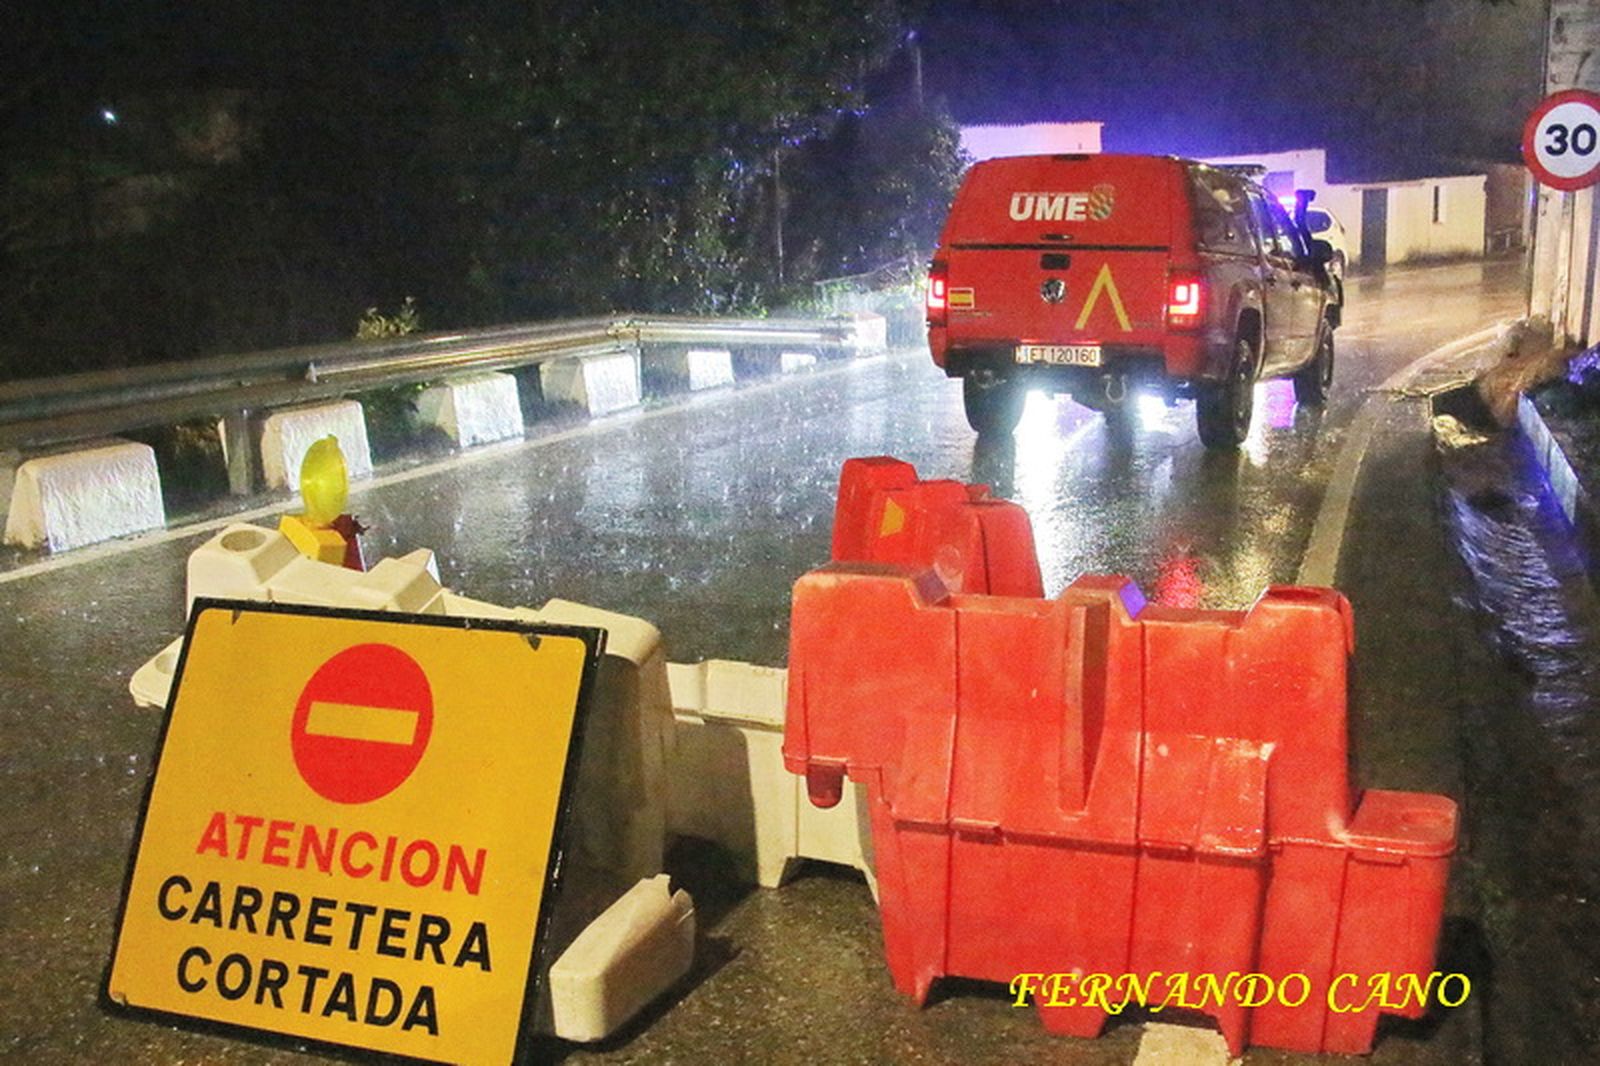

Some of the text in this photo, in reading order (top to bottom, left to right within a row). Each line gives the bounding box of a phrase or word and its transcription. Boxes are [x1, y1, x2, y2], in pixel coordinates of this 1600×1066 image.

[1545, 123, 1597, 156] 30
[1009, 192, 1088, 221] UME
[196, 811, 487, 896] ATENCION
[157, 875, 492, 972] CARRETERA
[177, 946, 439, 1036] CORTADA
